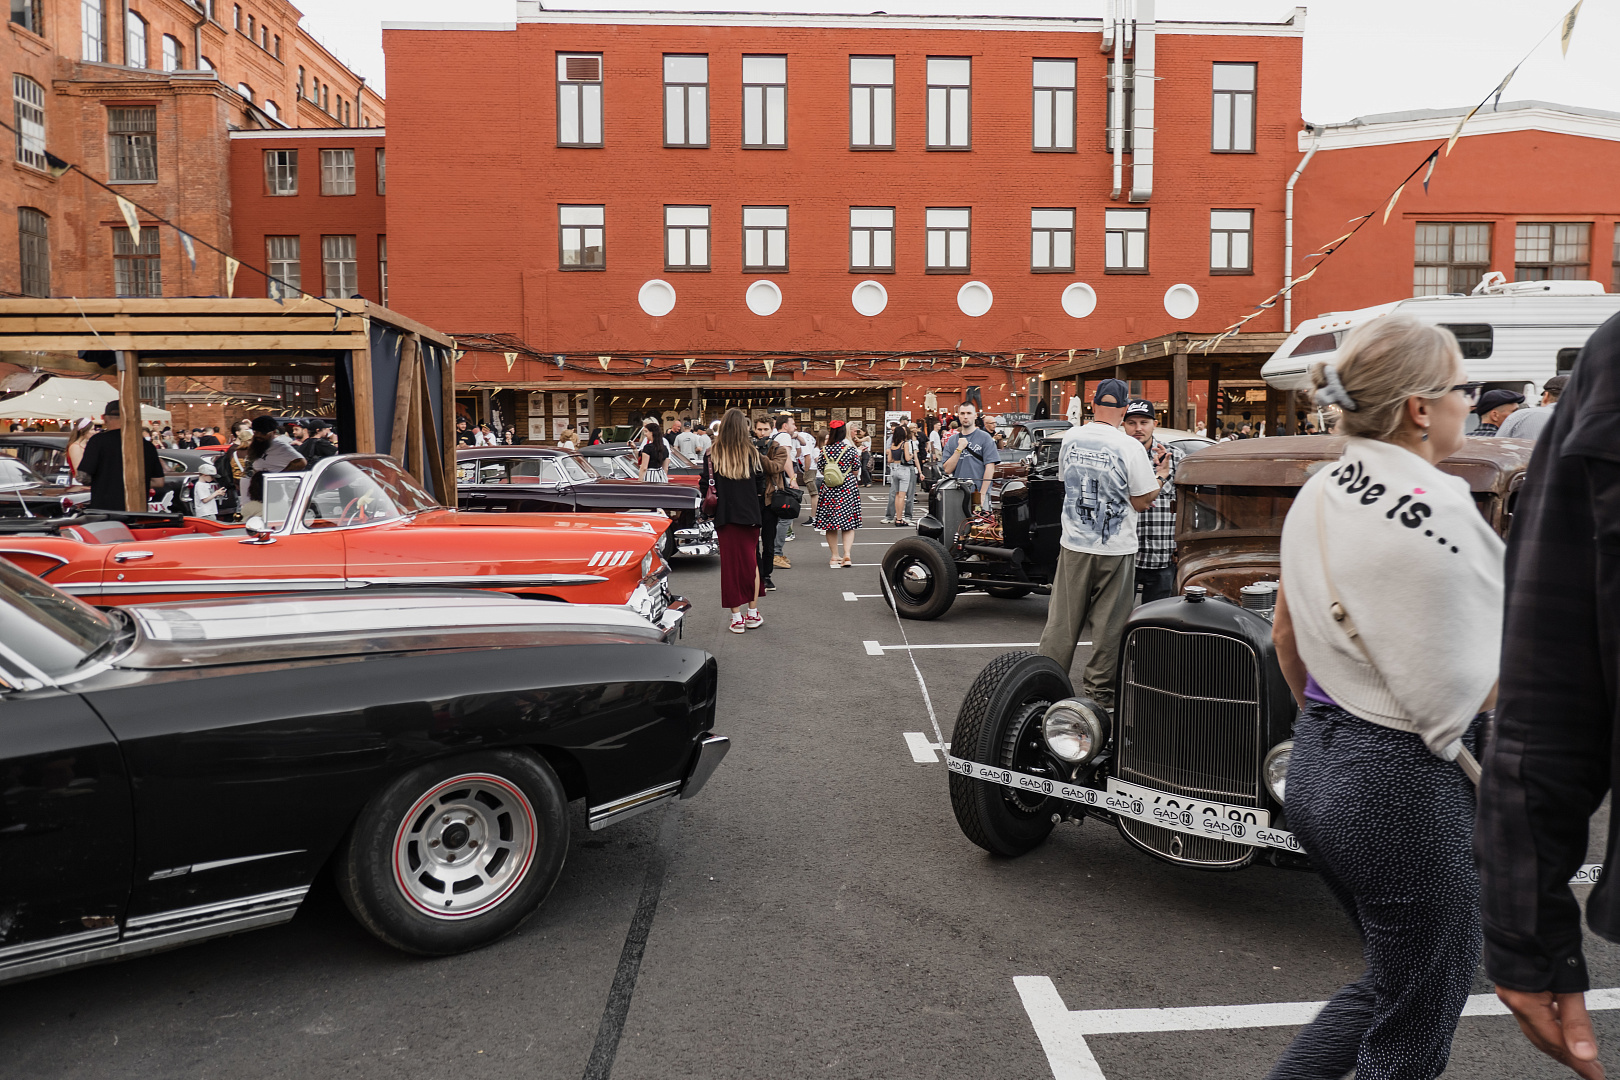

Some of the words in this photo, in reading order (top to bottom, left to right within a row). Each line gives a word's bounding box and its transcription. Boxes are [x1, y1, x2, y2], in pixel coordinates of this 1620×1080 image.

[980, 768, 1000, 779] GAD
[1020, 777, 1041, 789] GAD
[1061, 787, 1084, 799] GAD
[1106, 797, 1130, 809] GAD
[1153, 807, 1178, 820] GAD
[1203, 818, 1230, 831] GAD
[1256, 830, 1285, 844] GAD
